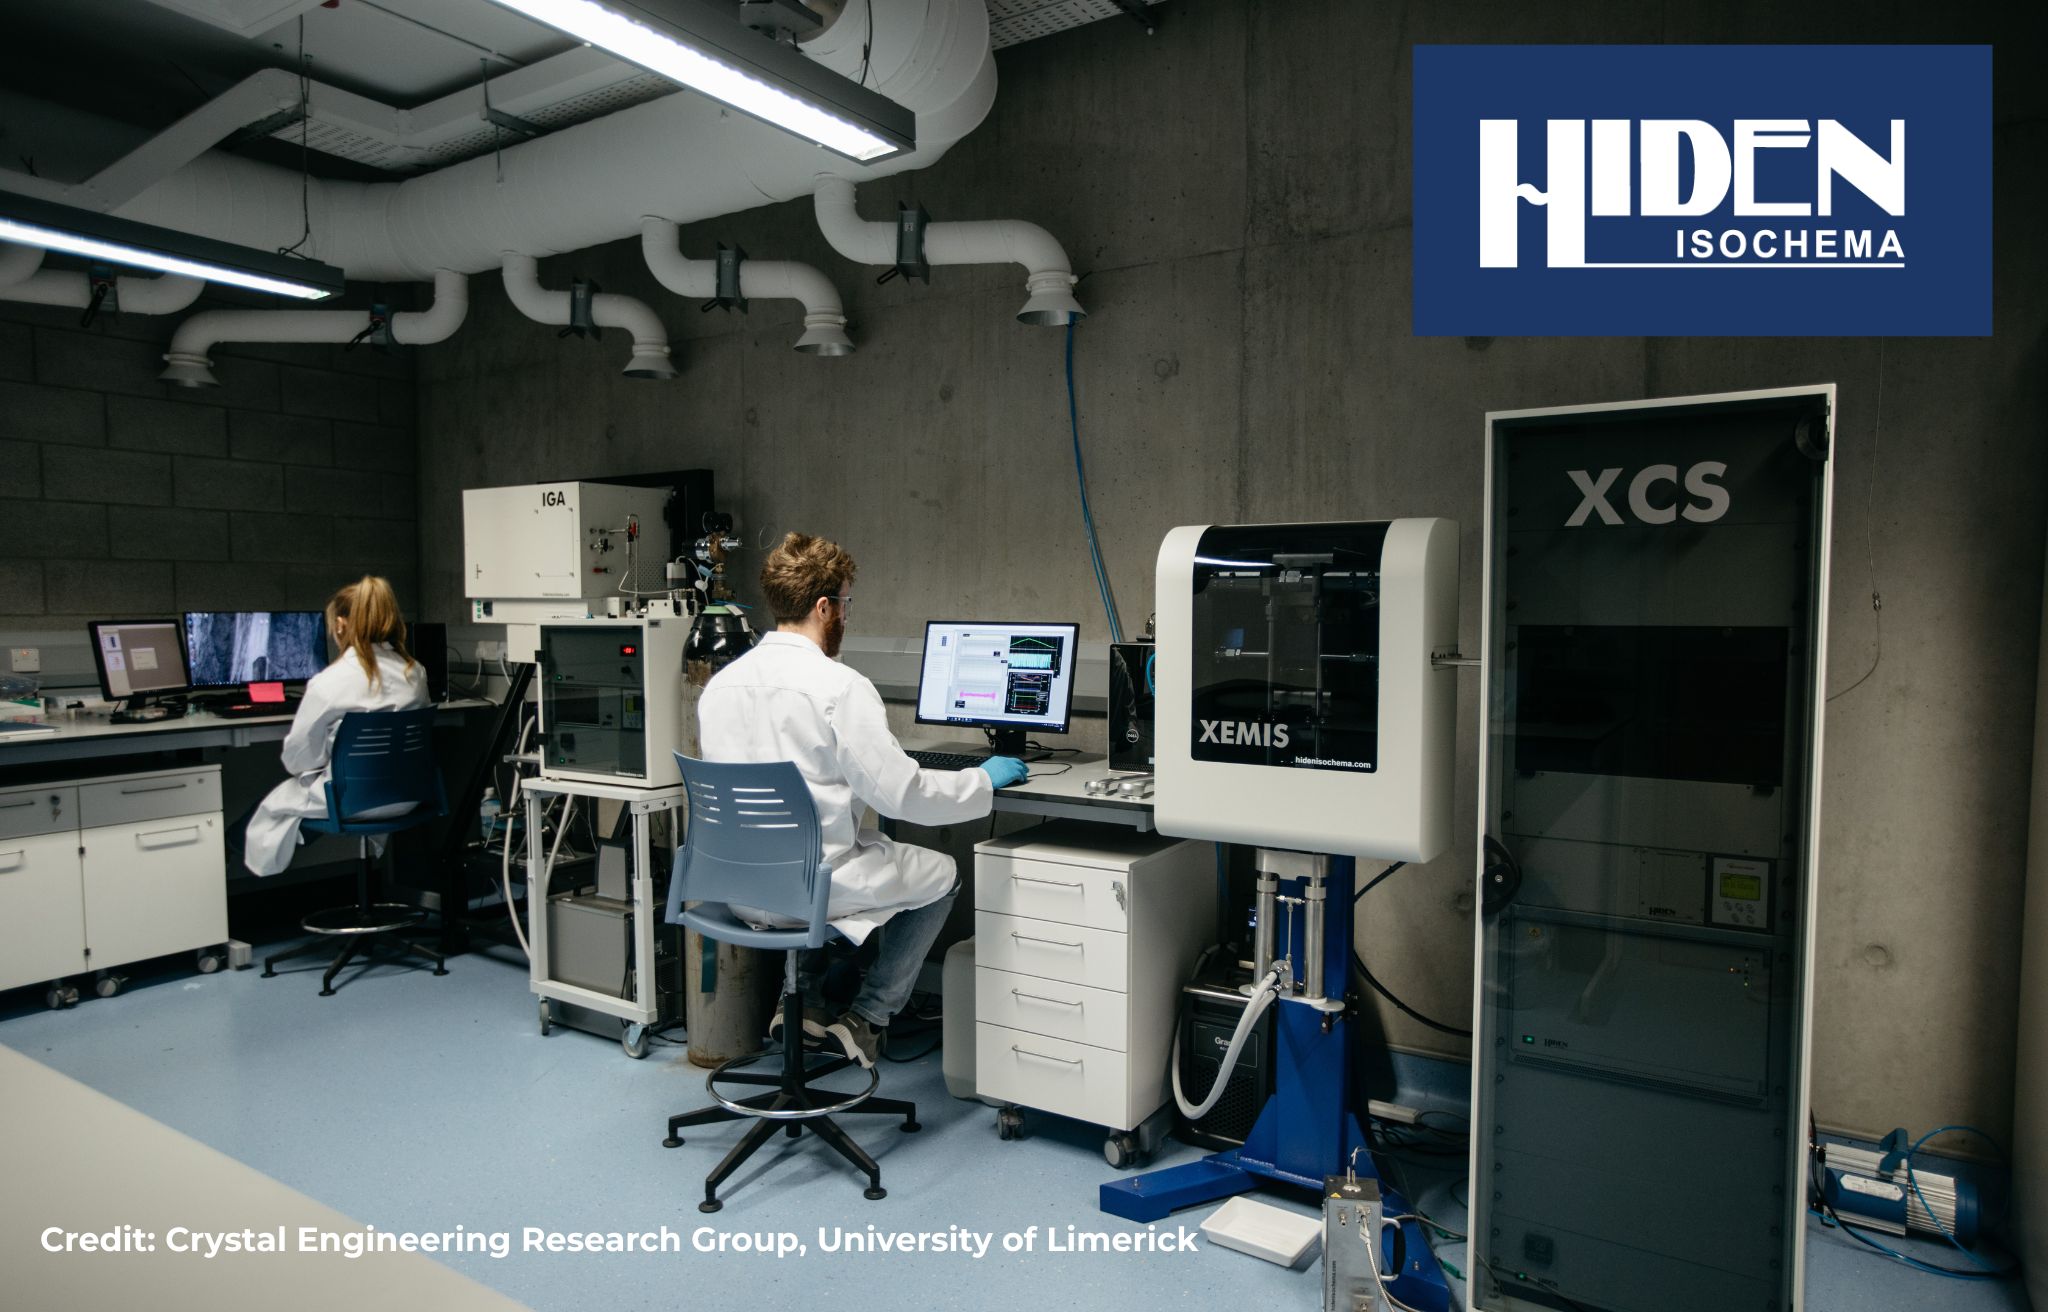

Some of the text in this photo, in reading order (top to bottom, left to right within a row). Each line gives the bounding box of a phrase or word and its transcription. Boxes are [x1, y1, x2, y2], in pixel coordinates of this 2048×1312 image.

[542, 491, 566, 507] IGA
[1564, 461, 1730, 527] XCS
[1198, 719, 1290, 749] XEMIS
[1295, 756, 1371, 769] hidenisochema.com
